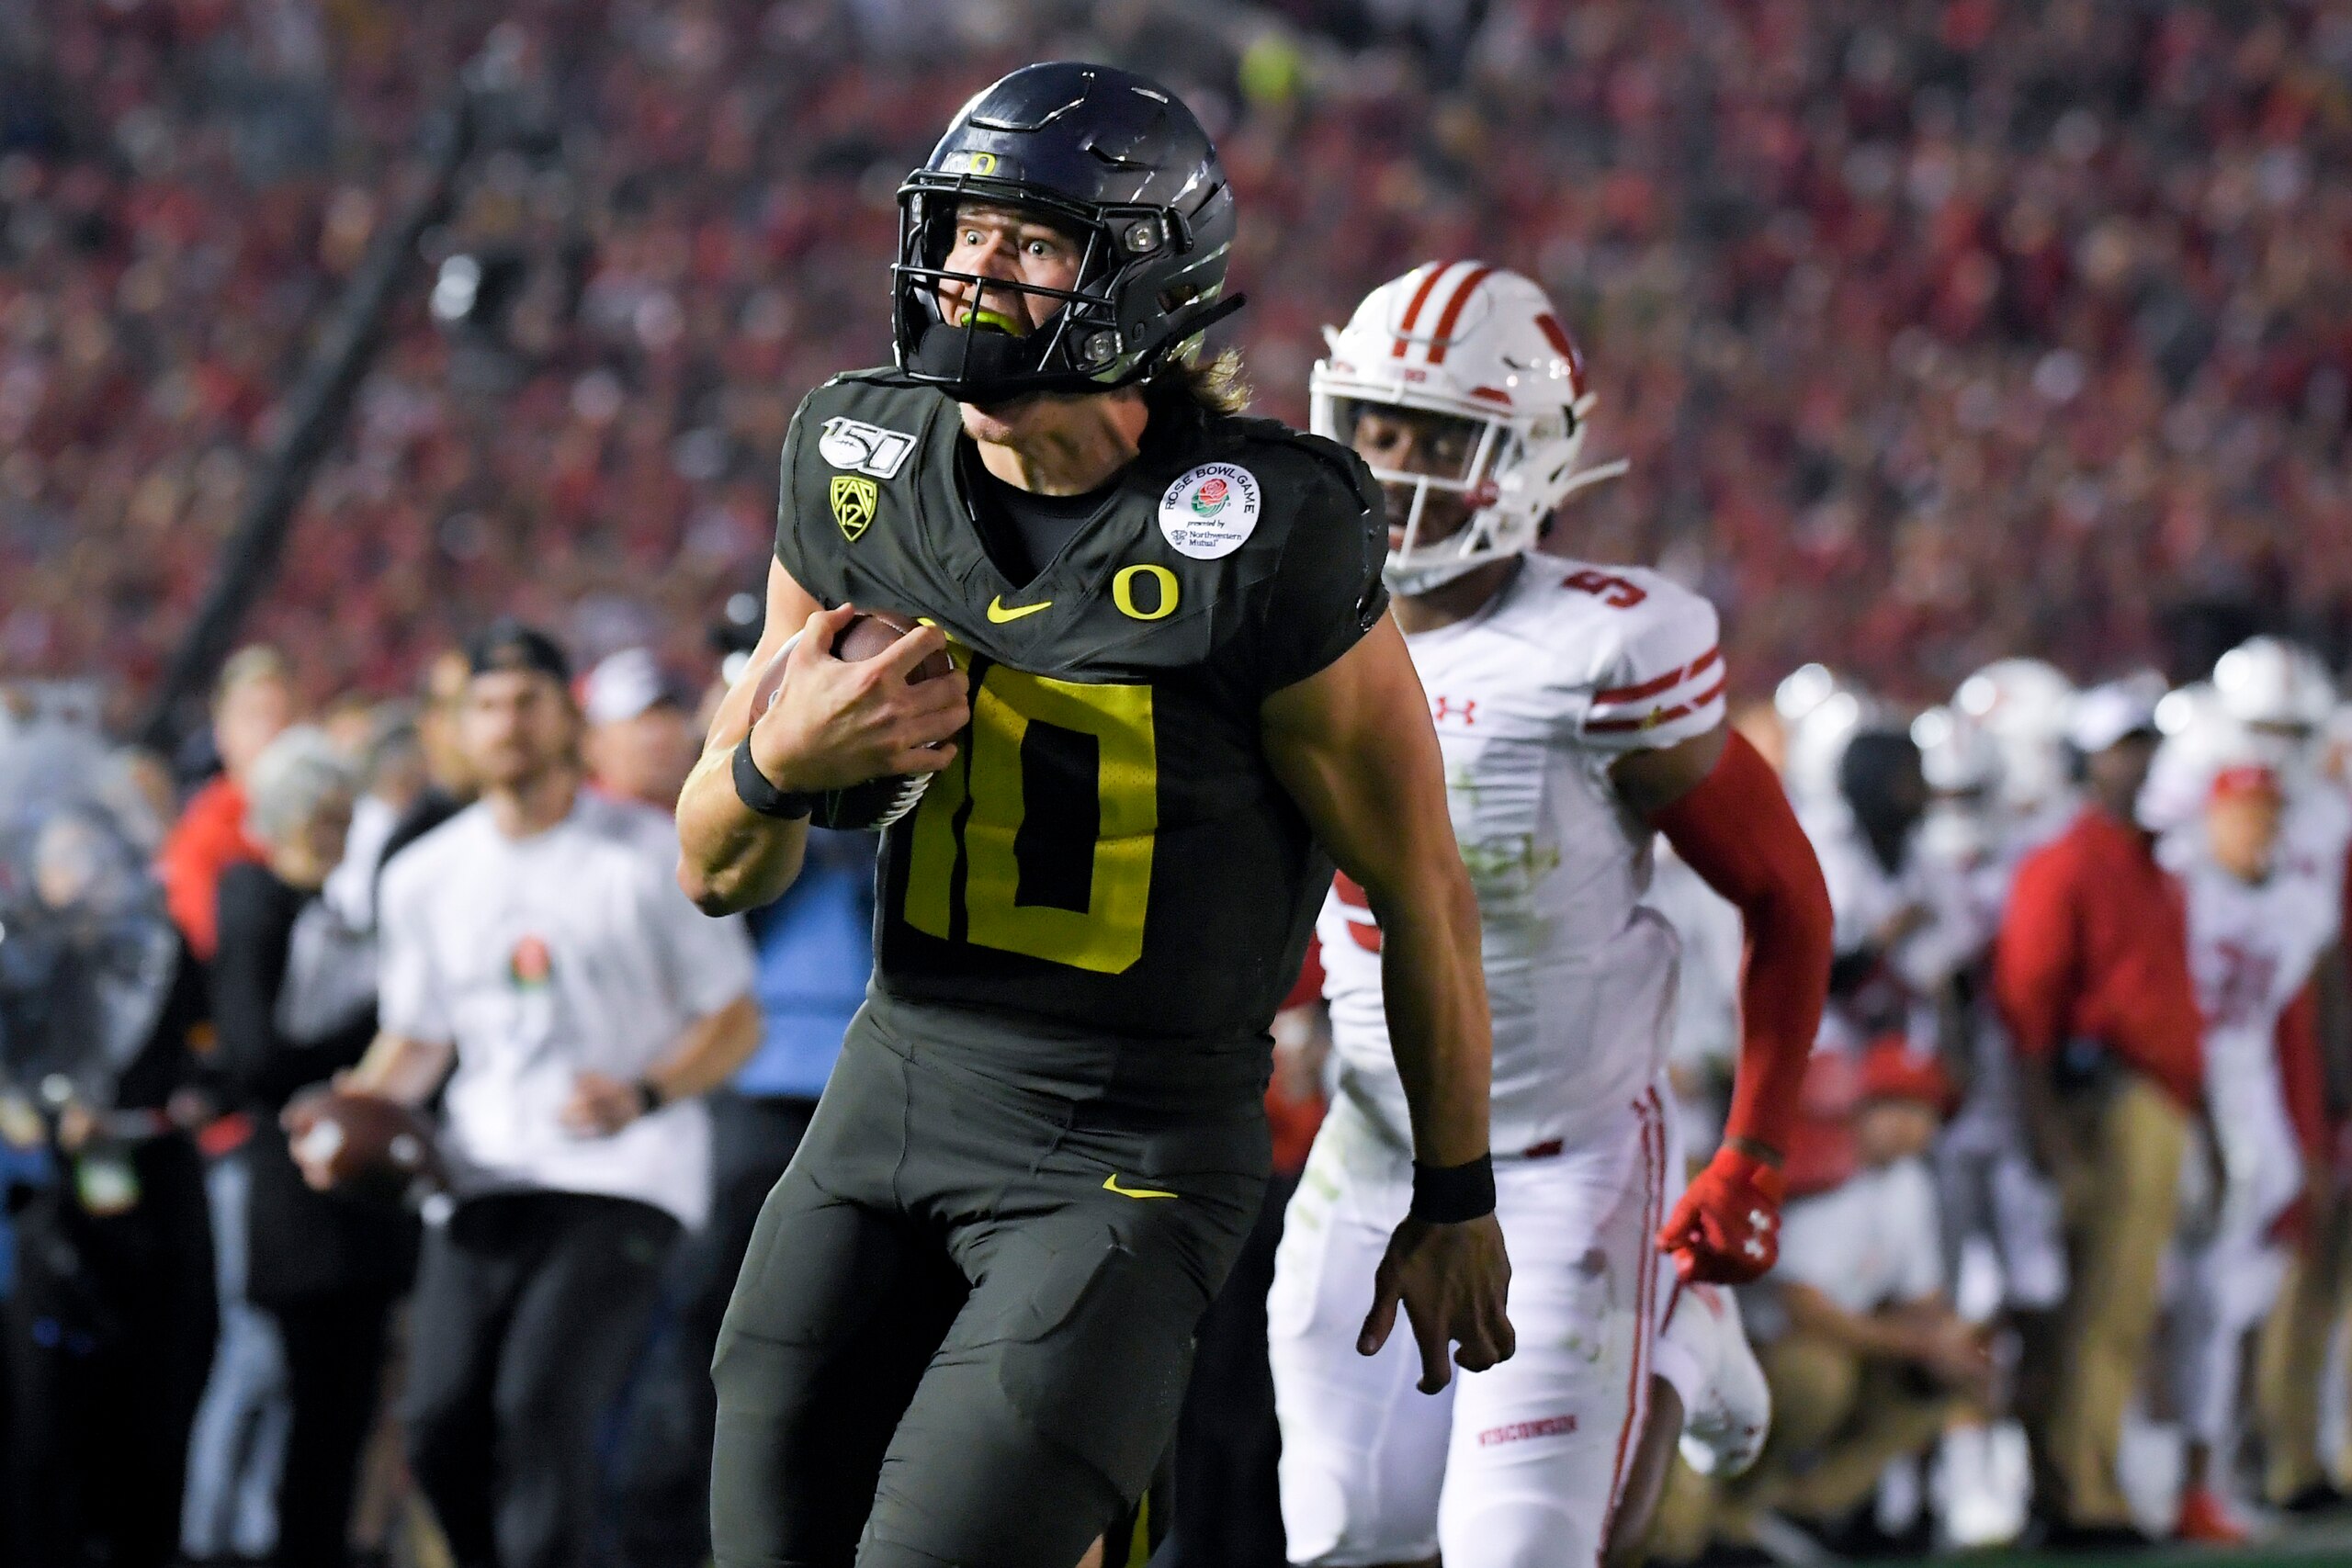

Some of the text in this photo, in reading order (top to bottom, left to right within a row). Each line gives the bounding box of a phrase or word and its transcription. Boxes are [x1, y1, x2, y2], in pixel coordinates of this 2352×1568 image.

[969, 152, 997, 176] O
[819, 416, 917, 479] 150
[833, 479, 875, 519] PAC
[1165, 466, 1255, 514] ROSE BOWL GAME
[841, 503, 864, 528] 12
[1187, 519, 1226, 529] presented by
[1189, 530, 1242, 541] Northwestern
[1112, 564, 1179, 620] O
[904, 619, 1158, 975] 10
